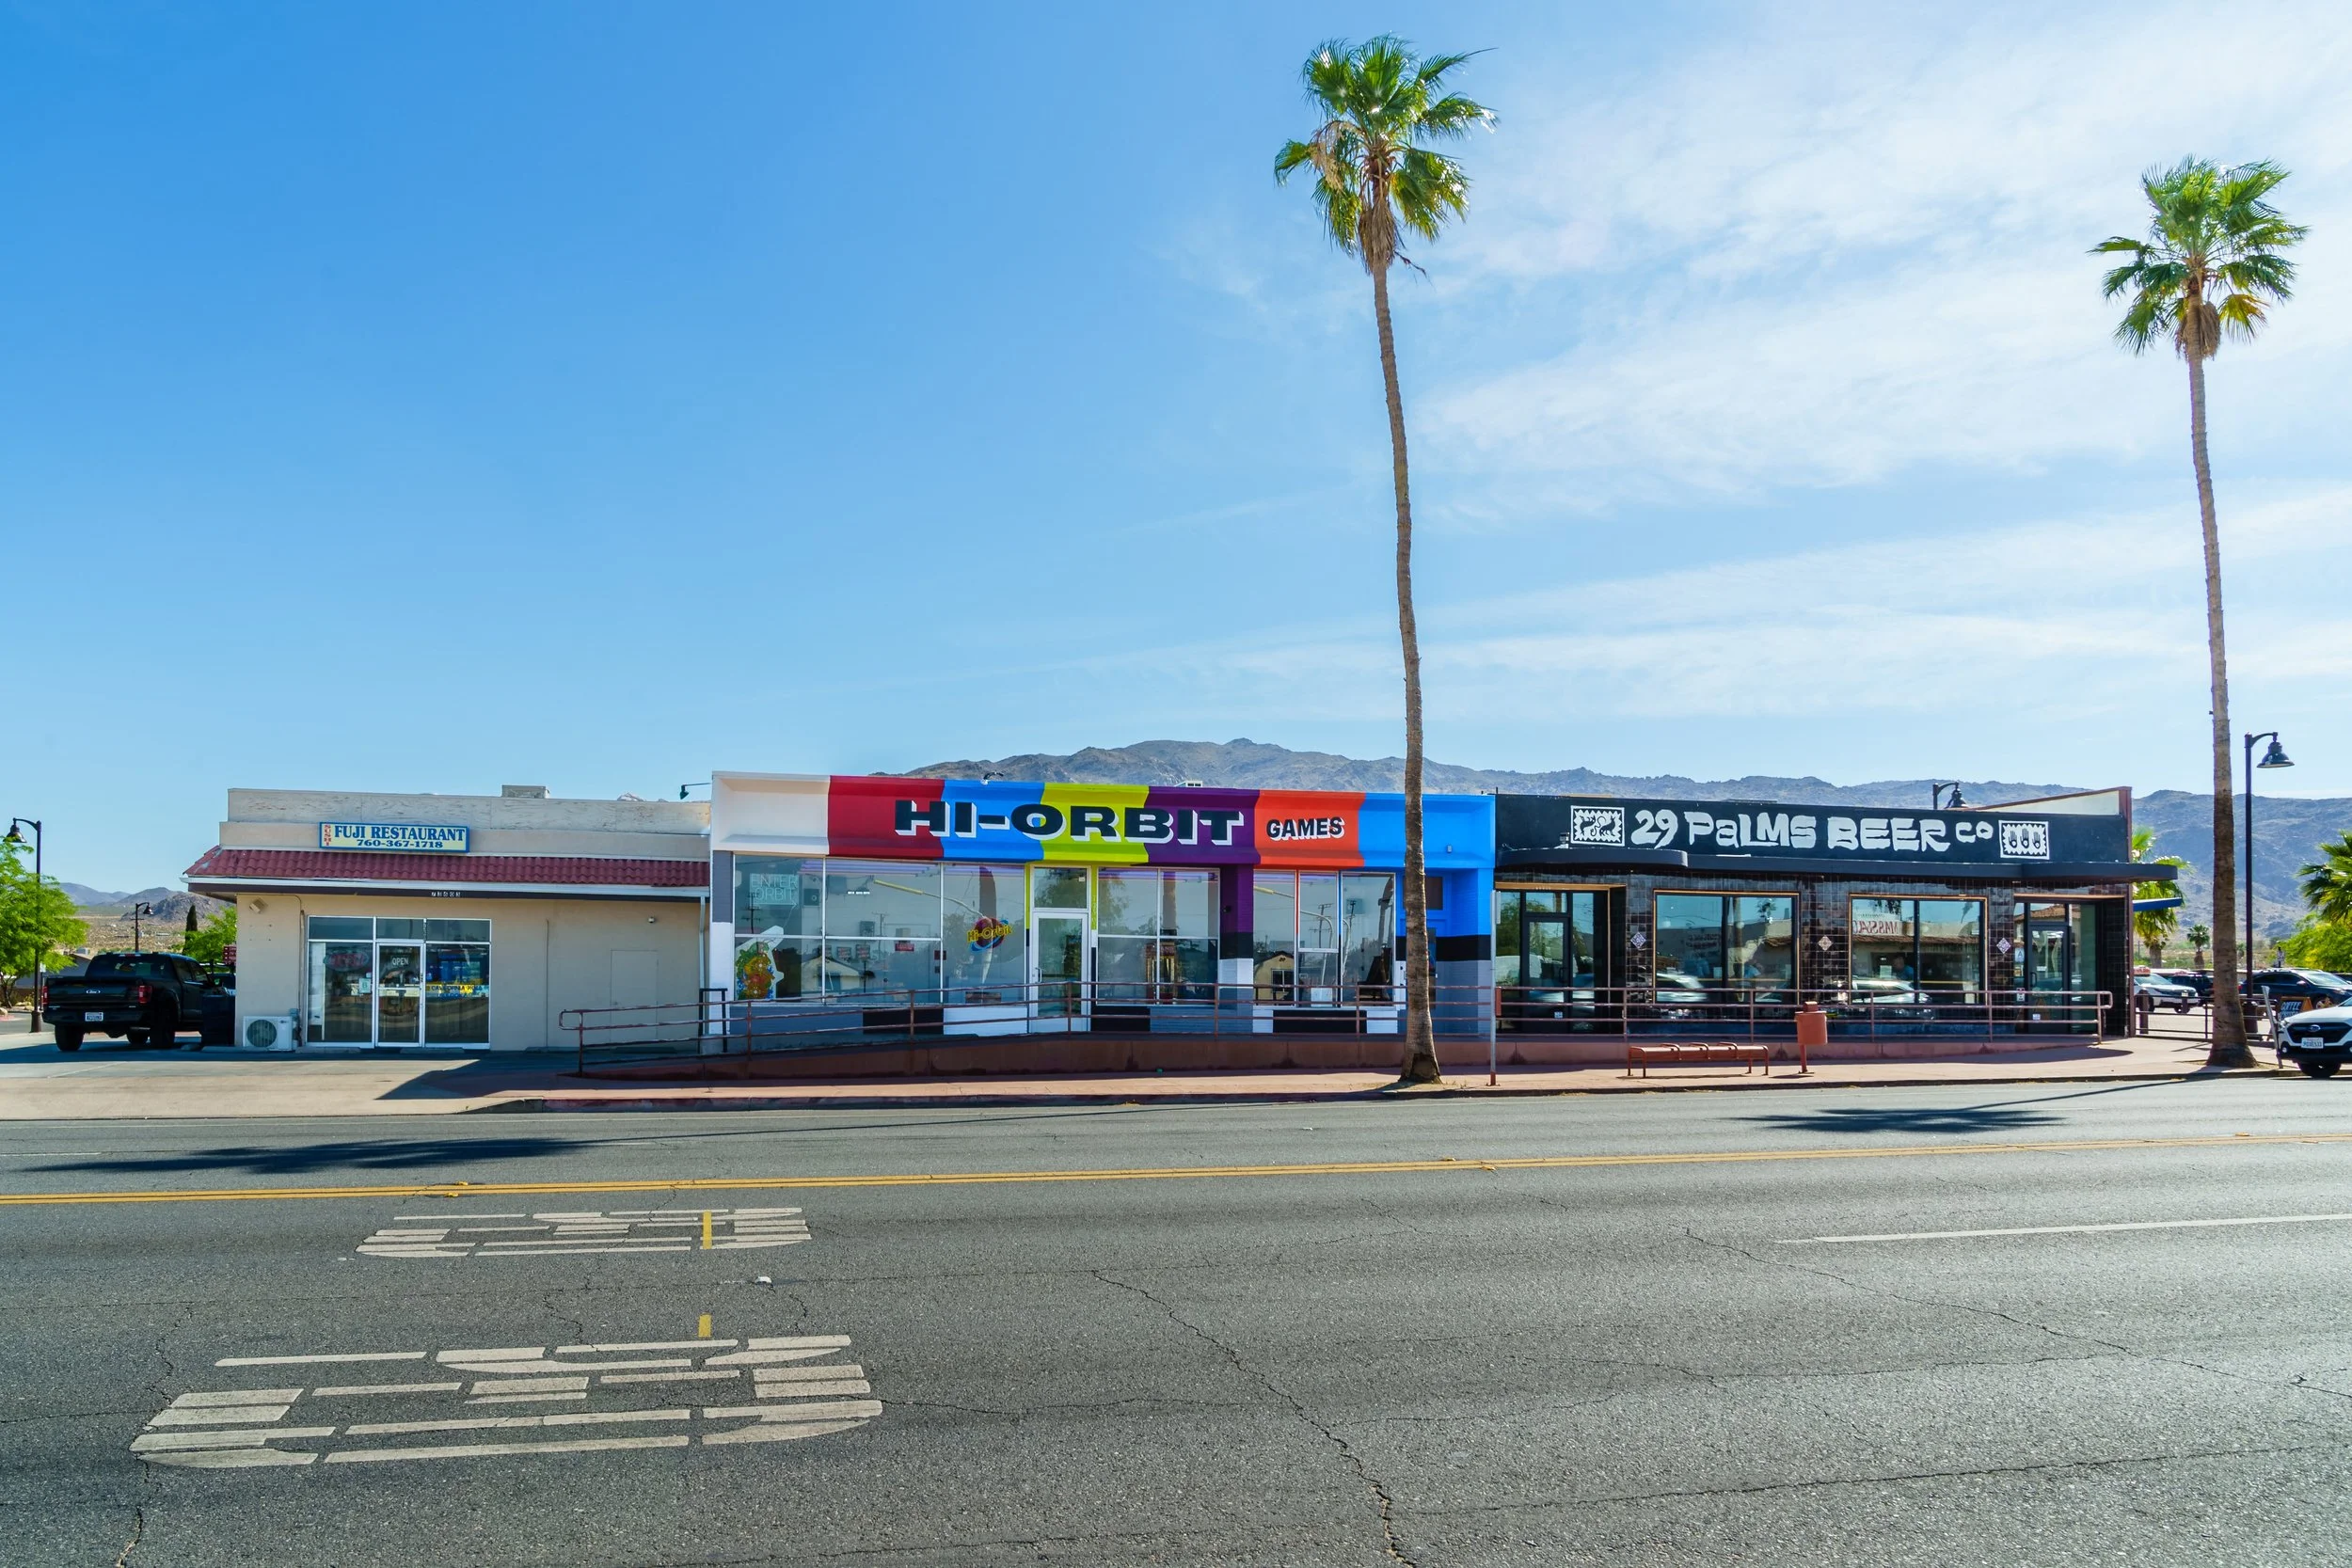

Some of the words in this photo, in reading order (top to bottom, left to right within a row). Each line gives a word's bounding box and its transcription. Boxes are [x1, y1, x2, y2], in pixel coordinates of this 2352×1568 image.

[895, 800, 1244, 845] HI-ORBIT
[1265, 816, 1344, 842] GAMES
[334, 826, 366, 838] FUJI
[371, 827, 465, 841] RESTAURANT
[1630, 809, 1678, 849] 29
[1827, 816, 1951, 852] BEER
[357, 839, 443, 848] 760-367-1718
[751, 874, 798, 889] ENTER
[755, 888, 793, 900] ORBIT
[967, 925, 1012, 942] Hi-Orbit
[391, 957, 409, 966] OPEN
